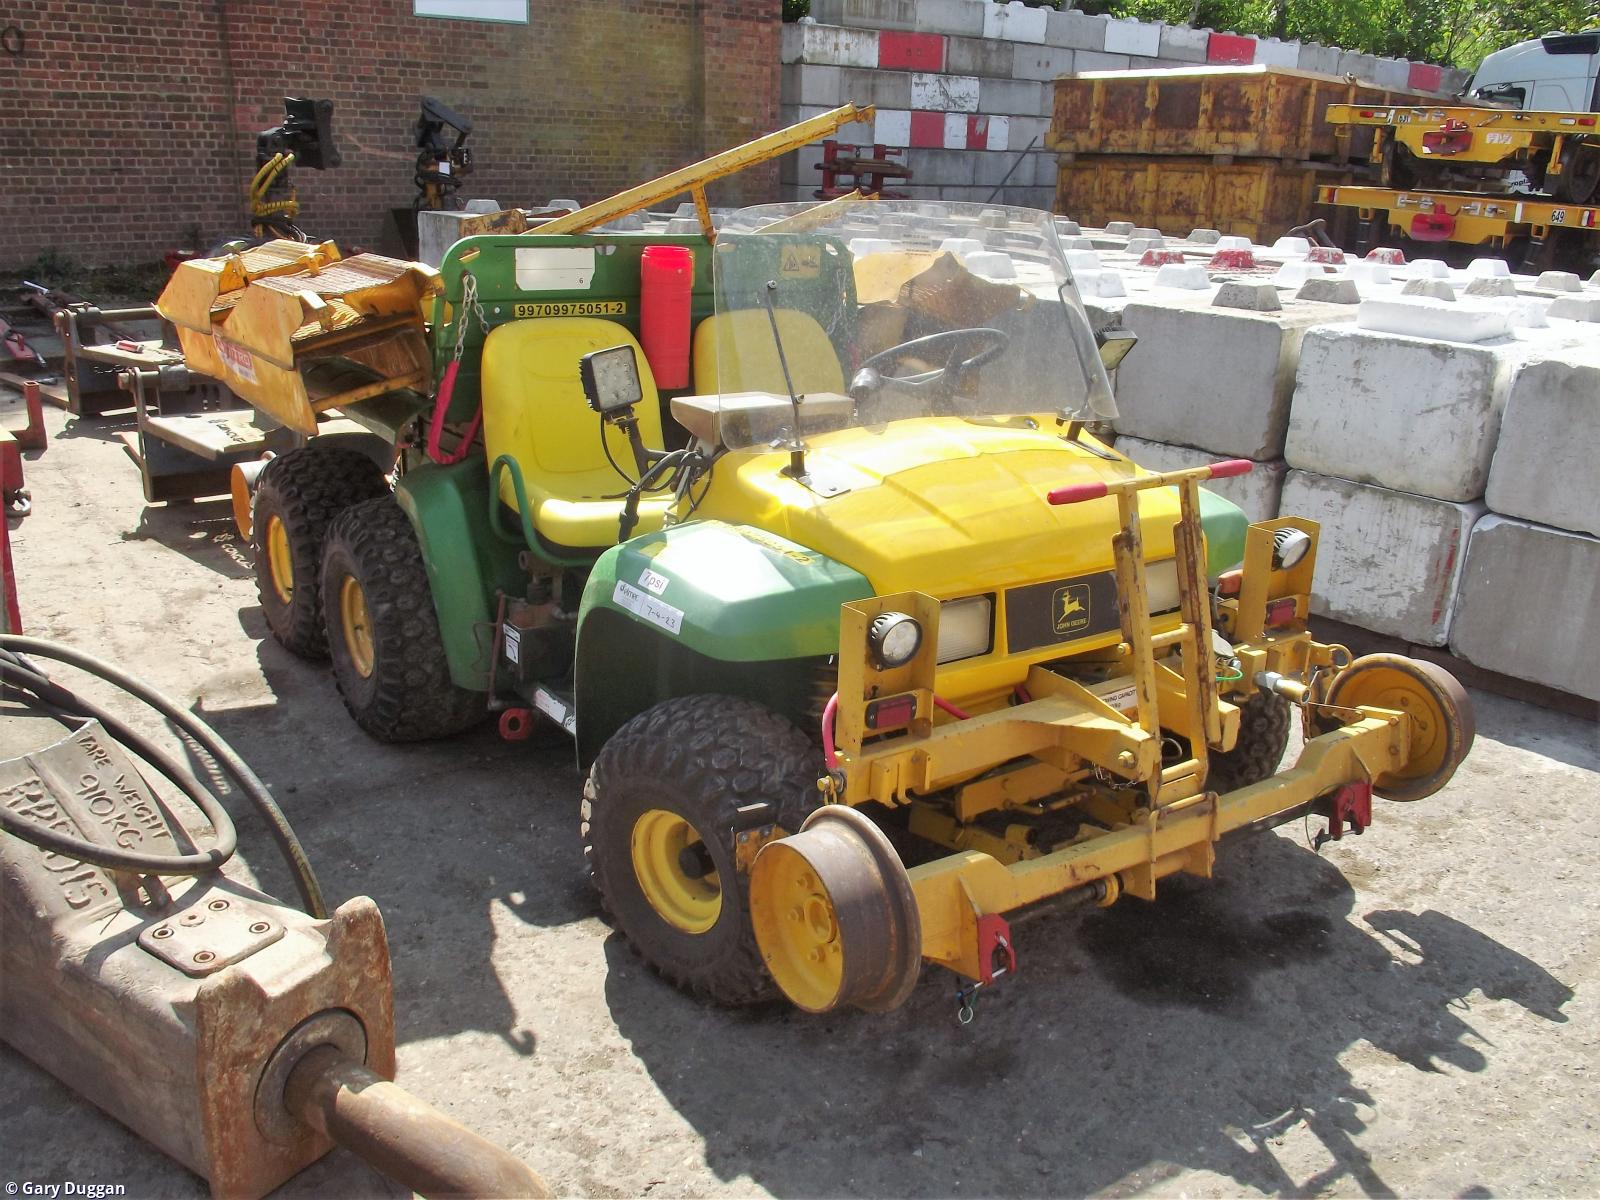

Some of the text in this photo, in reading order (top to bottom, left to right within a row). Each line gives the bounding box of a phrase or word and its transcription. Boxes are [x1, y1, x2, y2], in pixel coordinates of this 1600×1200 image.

[1552, 210, 1565, 222] 649
[518, 303, 623, 317] 99709975051-2
[645, 571, 664, 590] 7psi
[1057, 618, 1087, 630] JOHN DEERE
[77, 735, 172, 839] TARE WEIGHT
[76, 774, 143, 850] 910KG
